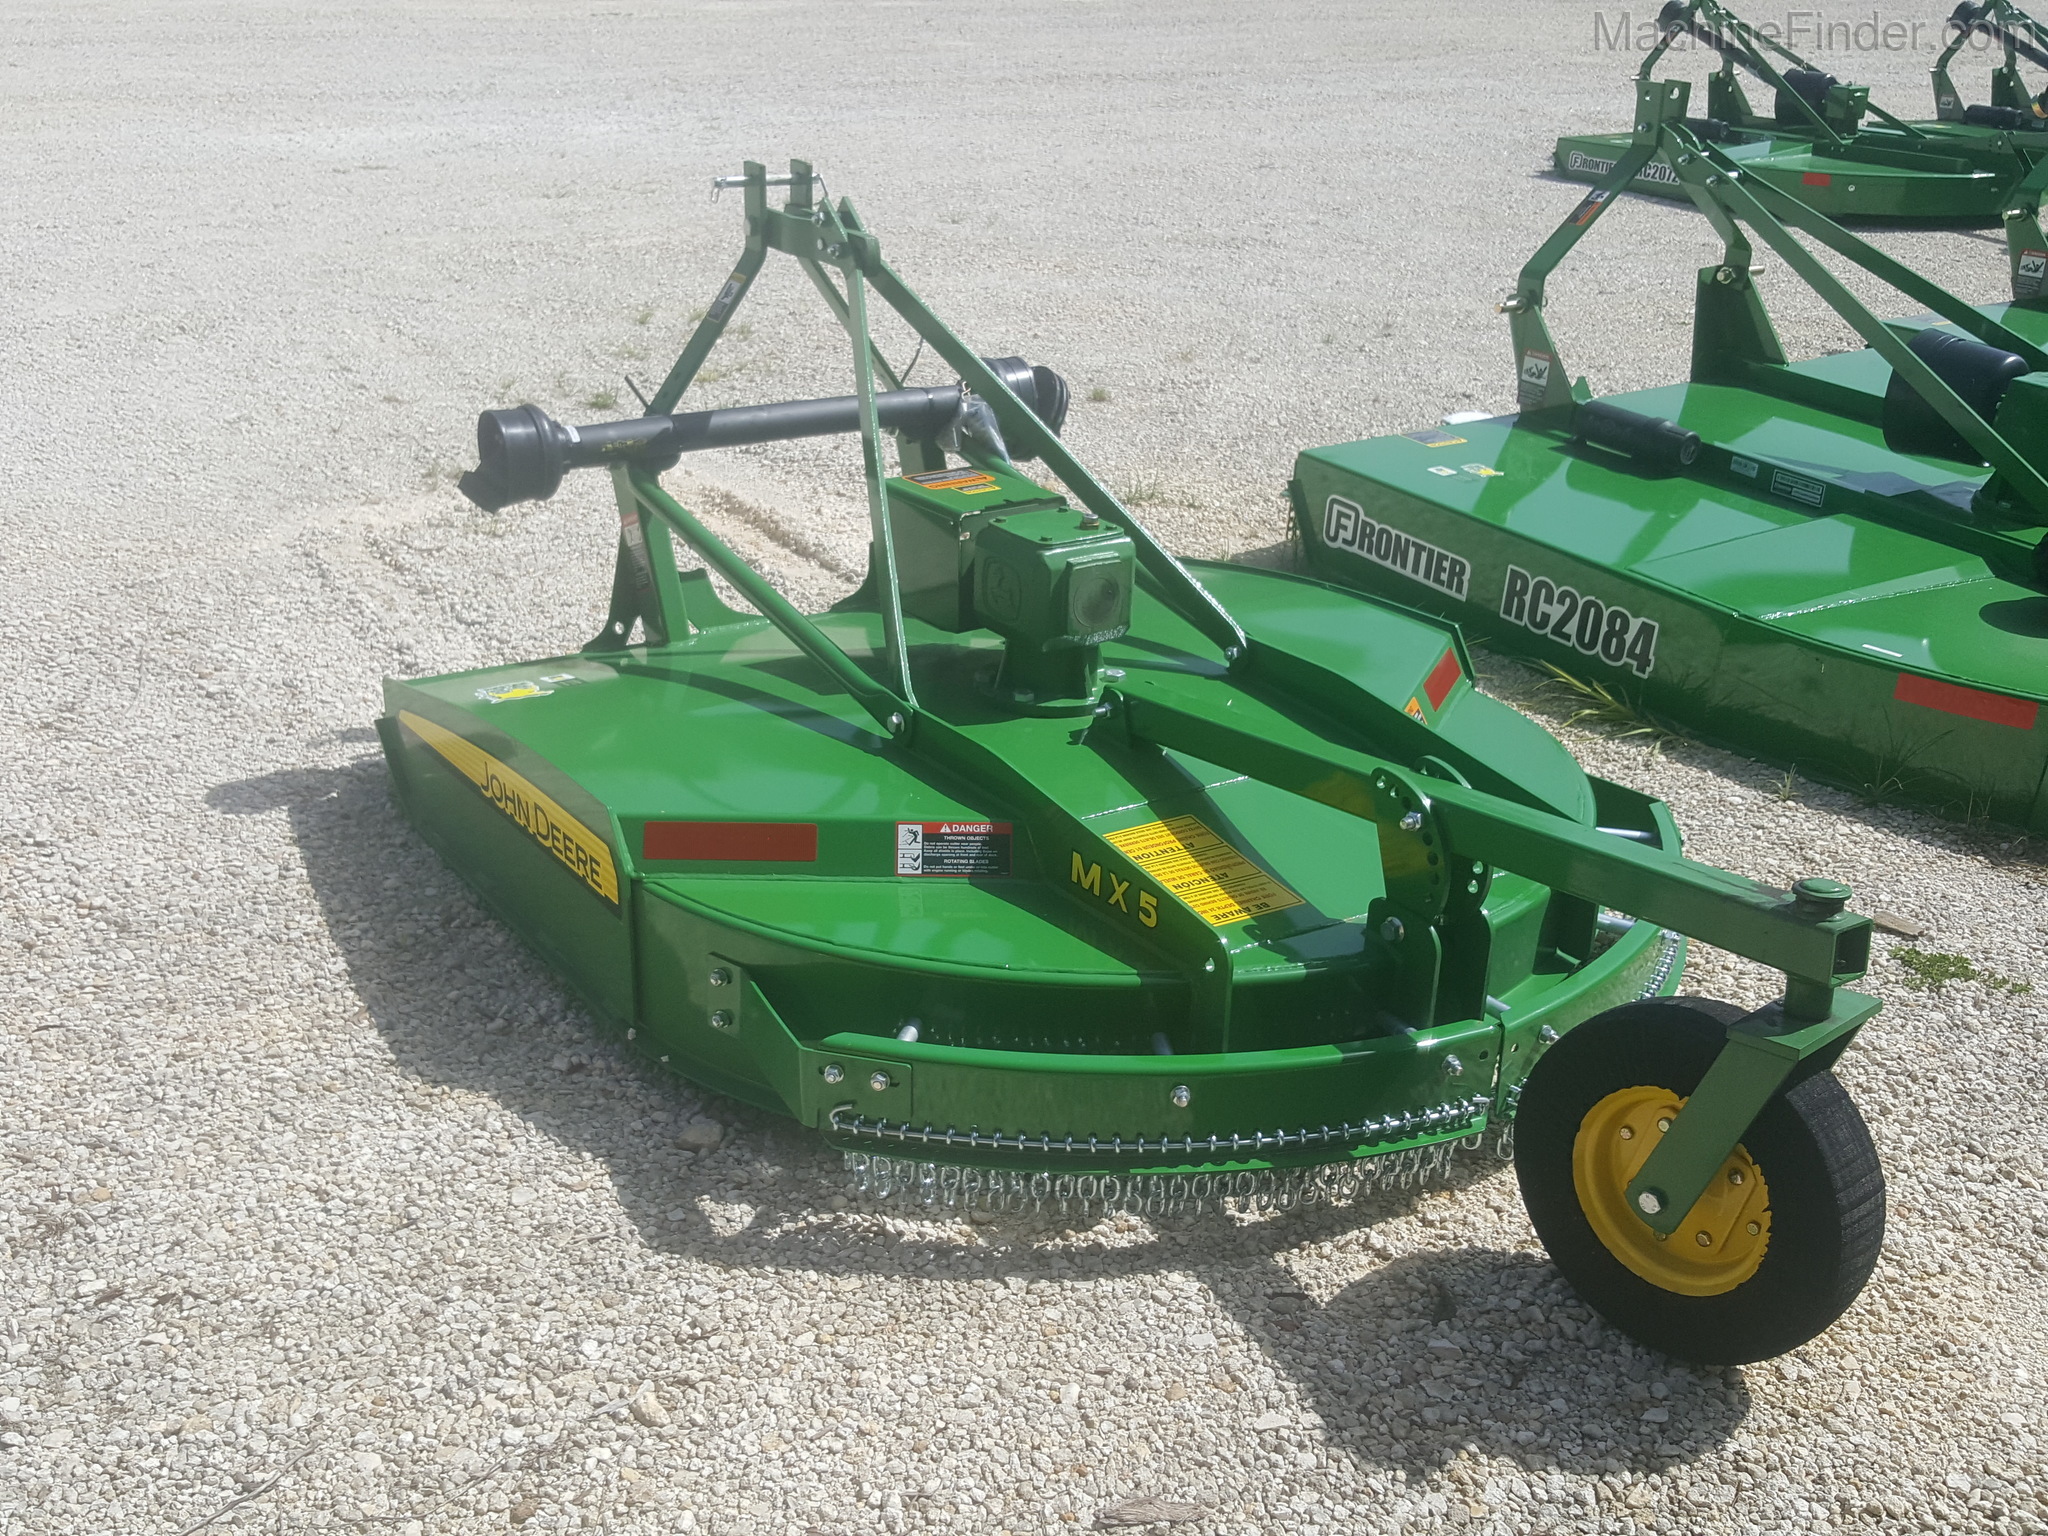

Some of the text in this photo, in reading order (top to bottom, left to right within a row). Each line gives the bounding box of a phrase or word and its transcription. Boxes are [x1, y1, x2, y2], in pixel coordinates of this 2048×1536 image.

[1325, 498, 1468, 598] FRONTIER
[1502, 567, 1656, 676] RC2084
[480, 760, 603, 890] JOHN DEERE
[952, 824, 993, 833] DANGER
[1132, 842, 1195, 861] ATTENTION
[1172, 872, 1231, 890] ATENCIÓN
[1212, 901, 1270, 920] BE AWARE
